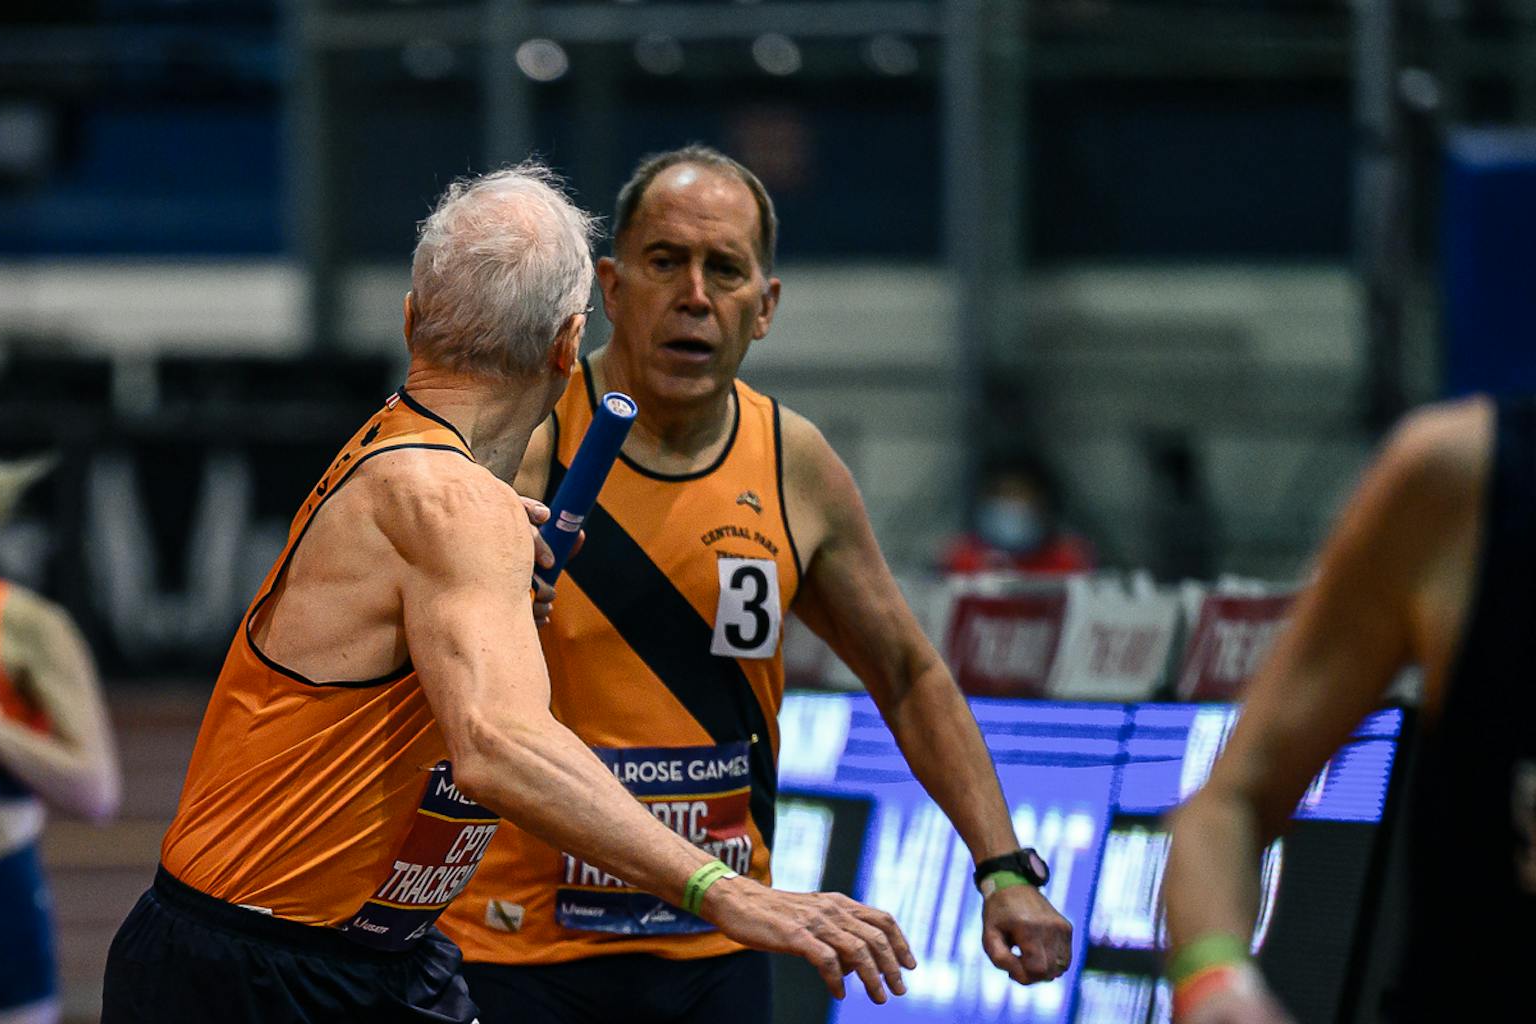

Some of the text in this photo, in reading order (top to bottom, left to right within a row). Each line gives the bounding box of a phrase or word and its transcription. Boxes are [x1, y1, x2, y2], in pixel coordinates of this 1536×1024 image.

[725, 566, 770, 650] 3
[644, 801, 708, 843] PTC
[378, 861, 476, 903] TRACKS
